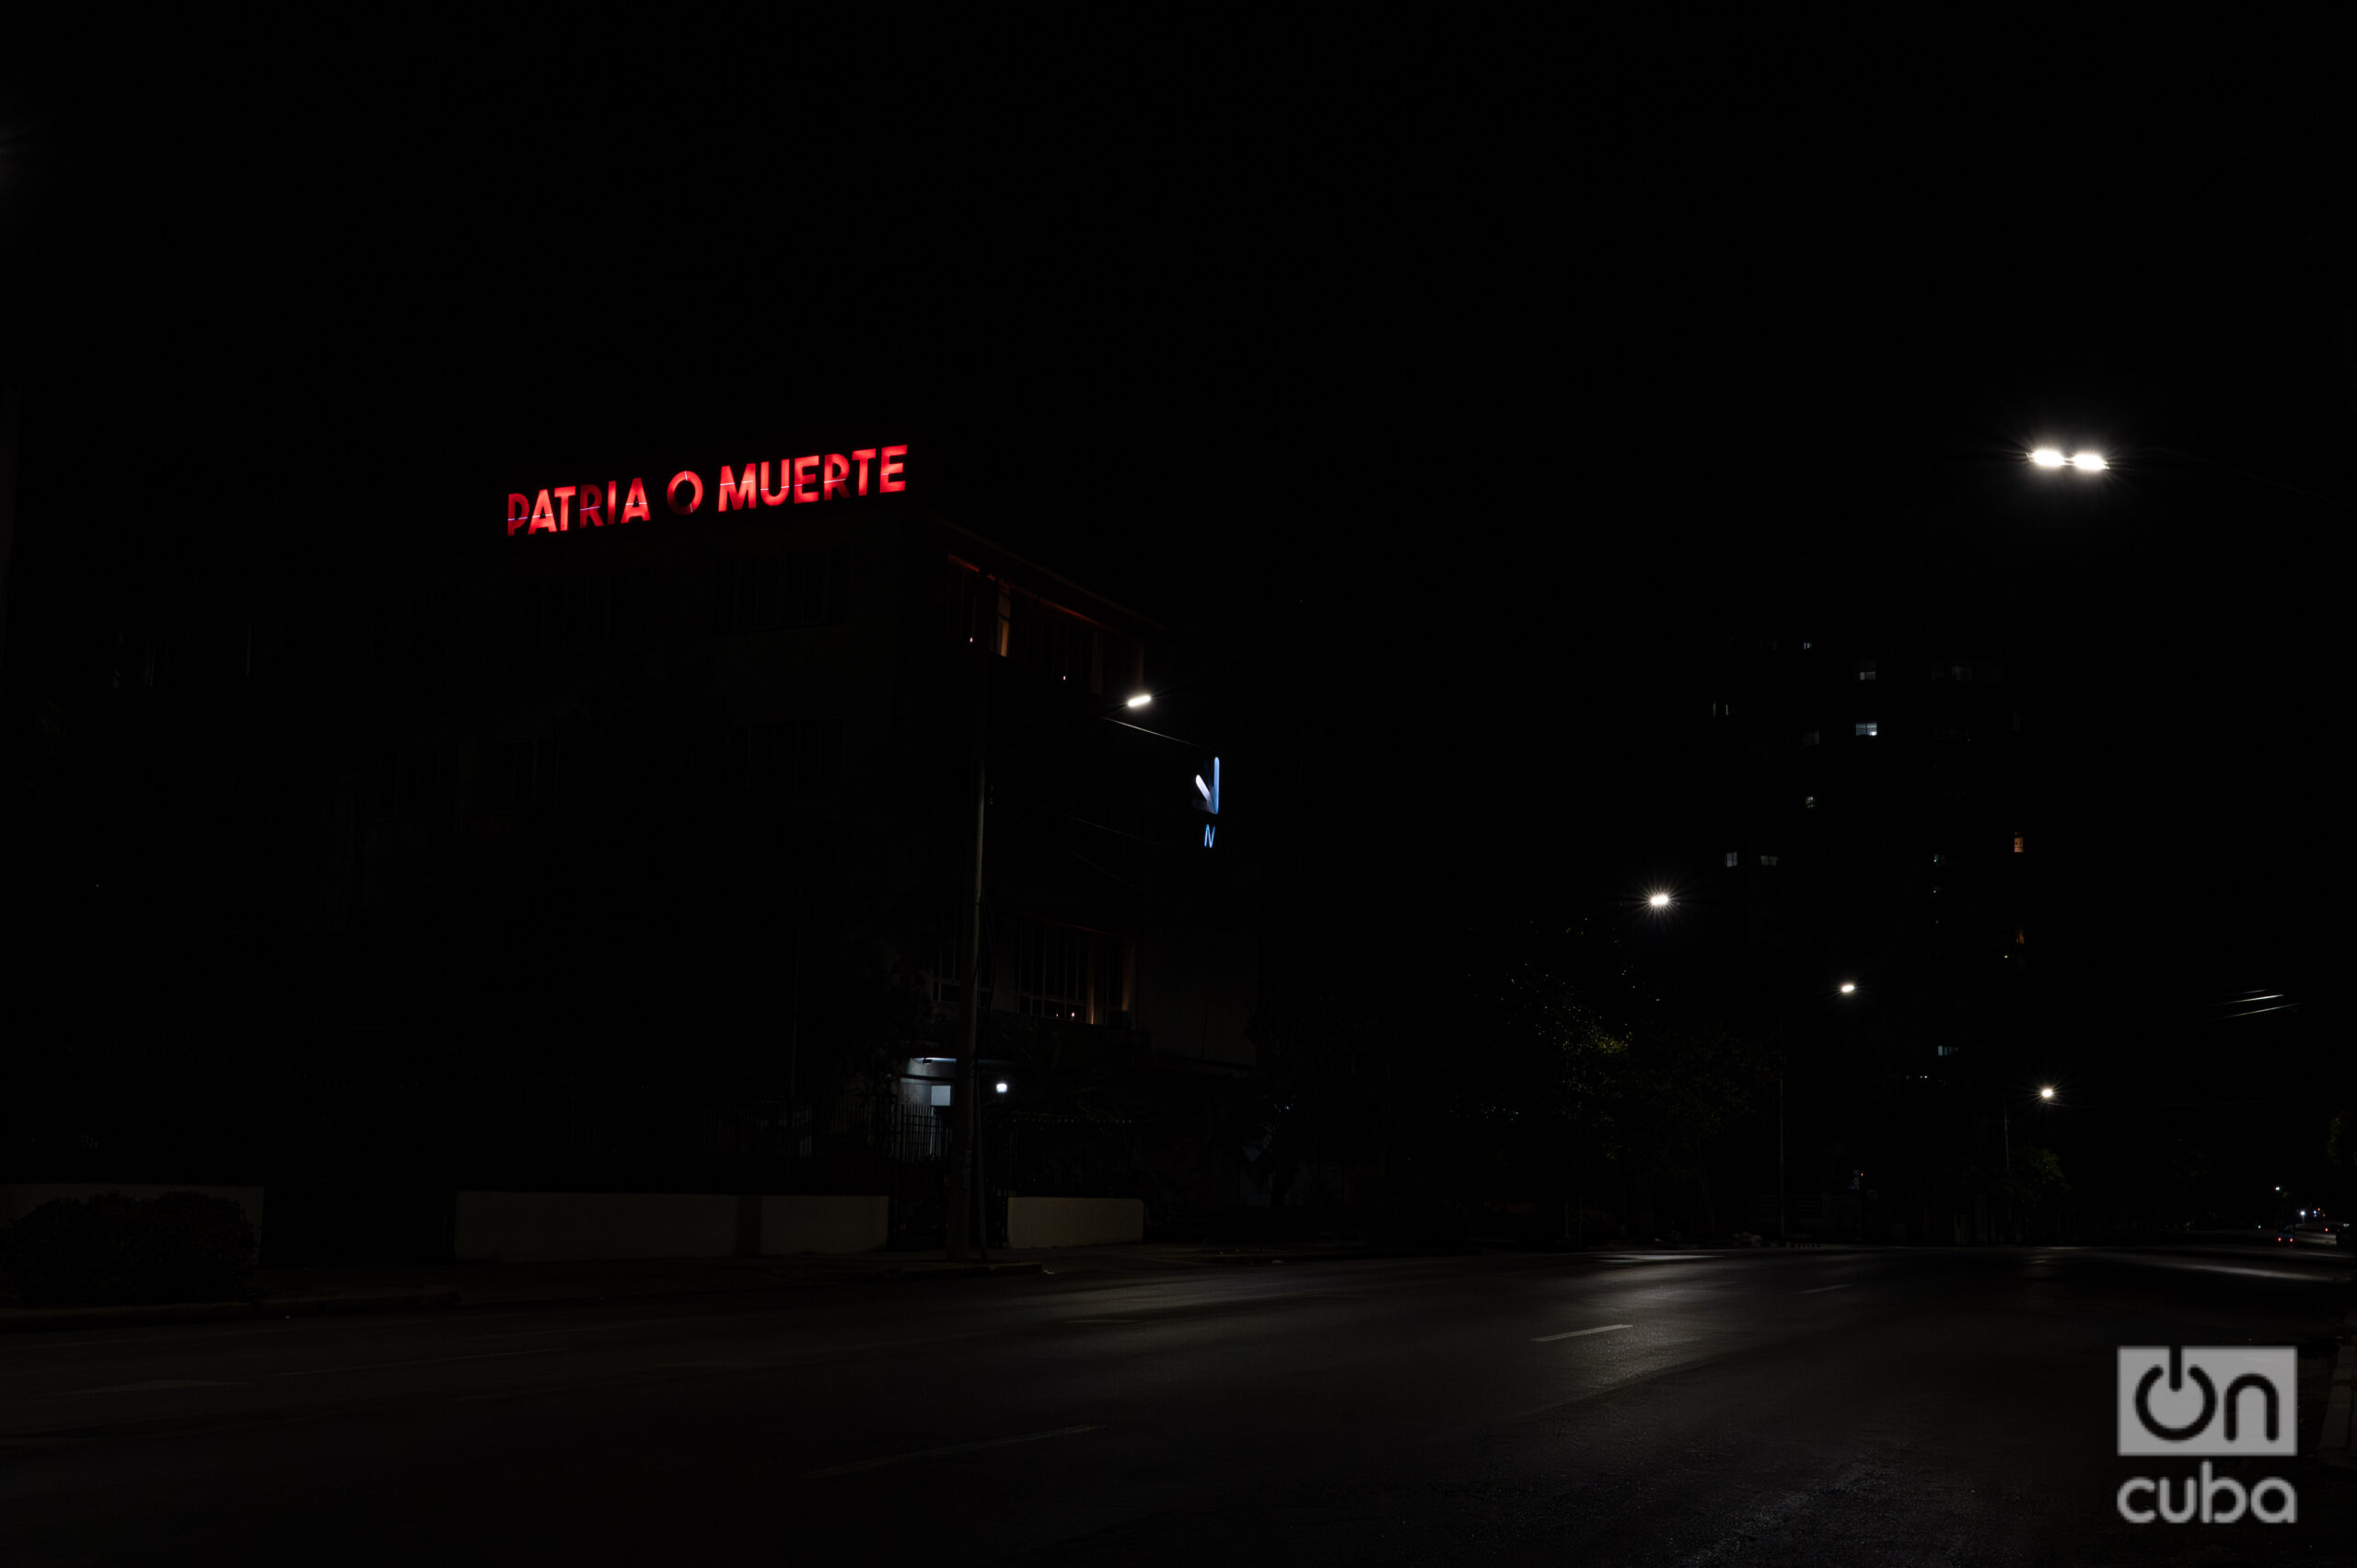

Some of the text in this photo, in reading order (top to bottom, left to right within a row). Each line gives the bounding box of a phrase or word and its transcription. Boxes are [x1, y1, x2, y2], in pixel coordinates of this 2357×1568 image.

[507, 444, 908, 536] PATRIA O MUERTE
